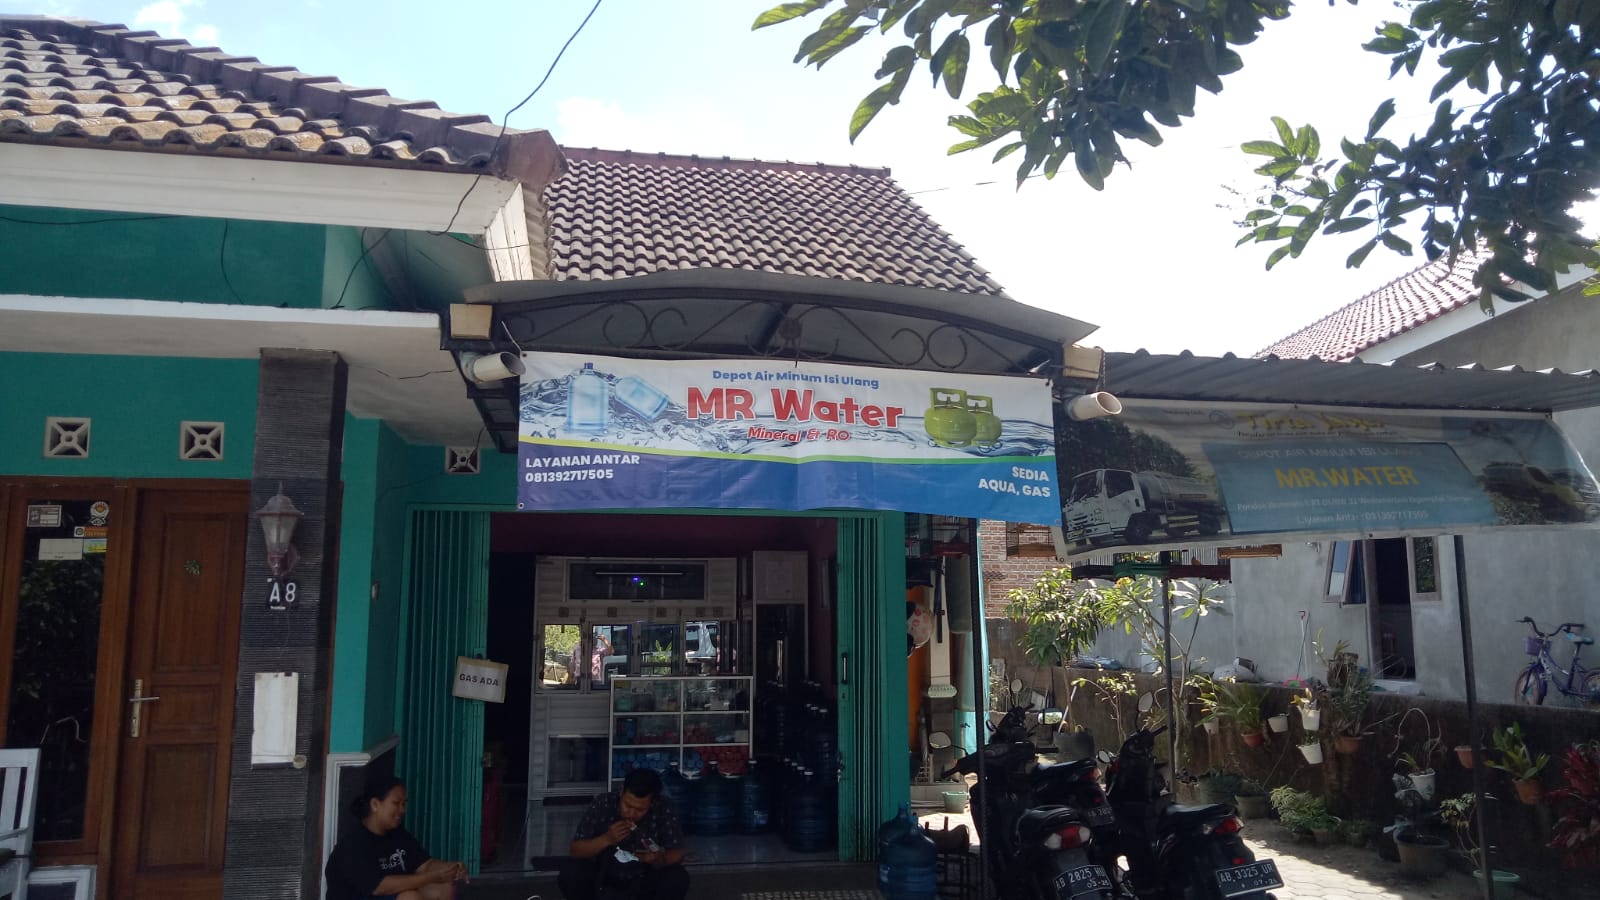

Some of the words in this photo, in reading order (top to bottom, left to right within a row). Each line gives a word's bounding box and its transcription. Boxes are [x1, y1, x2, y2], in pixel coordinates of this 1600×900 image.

[712, 370, 752, 383] Depot
[755, 370, 774, 381] Air
[776, 371, 822, 383] Minum
[824, 373, 840, 384] Isi
[841, 376, 880, 389] Ulang
[686, 386, 756, 420] MR
[770, 387, 905, 429] Water
[747, 426, 802, 442] Mineral
[826, 429, 851, 441] RO
[526, 455, 591, 469] LAYANAN
[593, 454, 640, 466] ANTAR
[525, 469, 614, 483] 081392717505
[1012, 466, 1049, 482] SEDIA
[1274, 465, 1419, 489] MR.WATER
[978, 478, 1020, 496] AQUA,
[1022, 485, 1051, 498] GAS
[459, 673, 478, 684] GAS
[480, 676, 499, 687] ADA
[1055, 877, 1066, 890] AB
[1068, 868, 1092, 884] 2825
[1220, 870, 1232, 883] AB
[1234, 866, 1259, 880] 3325
